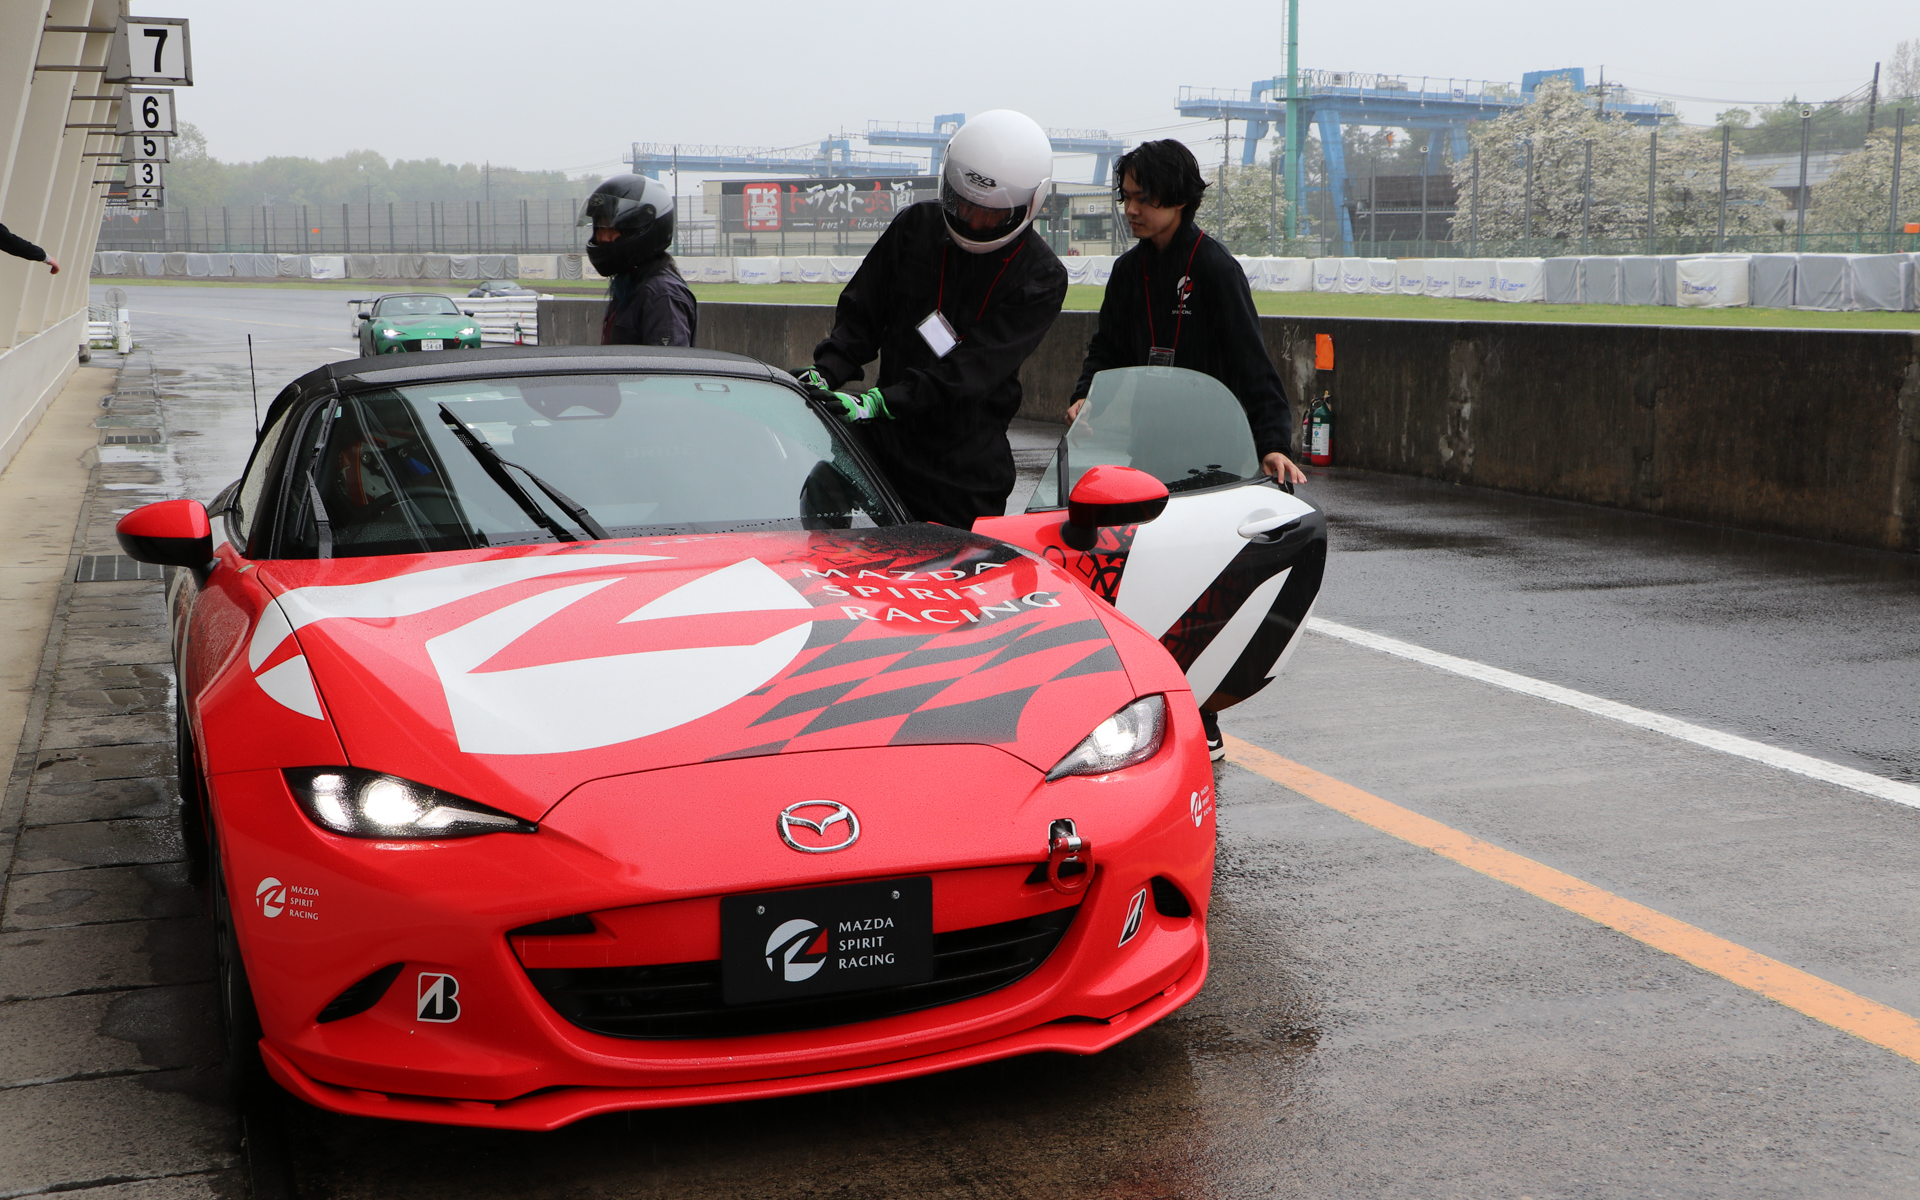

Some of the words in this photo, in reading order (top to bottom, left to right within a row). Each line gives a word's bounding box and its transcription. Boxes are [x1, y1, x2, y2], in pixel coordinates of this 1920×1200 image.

[143, 28, 168, 73] 7
[142, 95, 160, 129] 6
[143, 135, 157, 157] 5
[142, 163, 154, 184] 3
[747, 188, 778, 206] TK
[801, 562, 1007, 582] MAZDA
[822, 582, 988, 601] SPIRIT
[840, 591, 1061, 625] RACING
[290, 885, 320, 897] MAZDA
[289, 897, 314, 908] SPIRIT
[289, 909, 319, 921] RACING
[838, 917, 895, 933] MAZDA
[839, 935, 885, 952] SPIRIT
[838, 952, 895, 970] RACING
